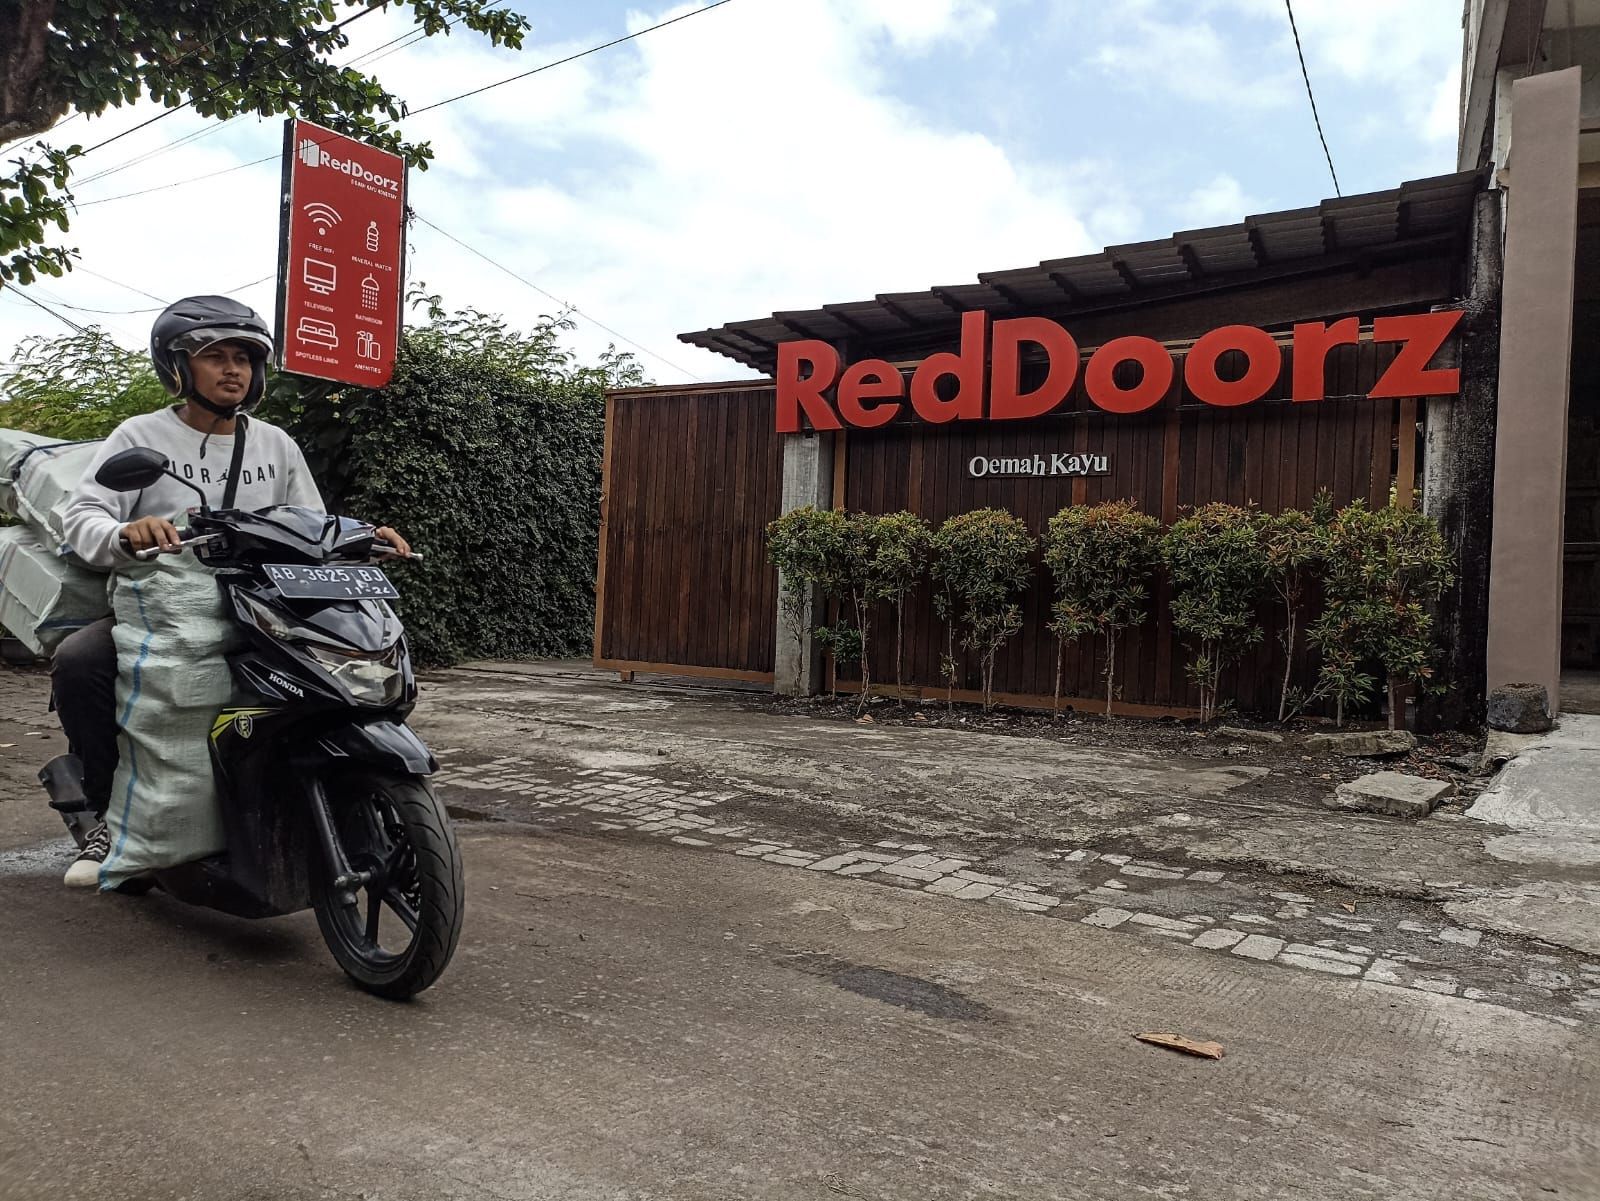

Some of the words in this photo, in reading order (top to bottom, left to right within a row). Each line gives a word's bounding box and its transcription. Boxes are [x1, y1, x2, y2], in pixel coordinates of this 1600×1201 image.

[320, 150, 398, 191] RedDoorz
[308, 242, 322, 252] FREE
[304, 300, 334, 313] TELEVISION
[355, 313, 383, 325] BATHROOM
[295, 350, 322, 362] SPOTLESS
[323, 356, 339, 365] LINEN
[354, 363, 382, 374] AMENITIES
[775, 310, 1465, 433] RedDoorz
[969, 454, 1046, 477] Oemah
[1050, 452, 1108, 475] Kayu
[270, 567, 296, 580] AB
[302, 568, 351, 582] 3625
[269, 673, 304, 697] HONDA
